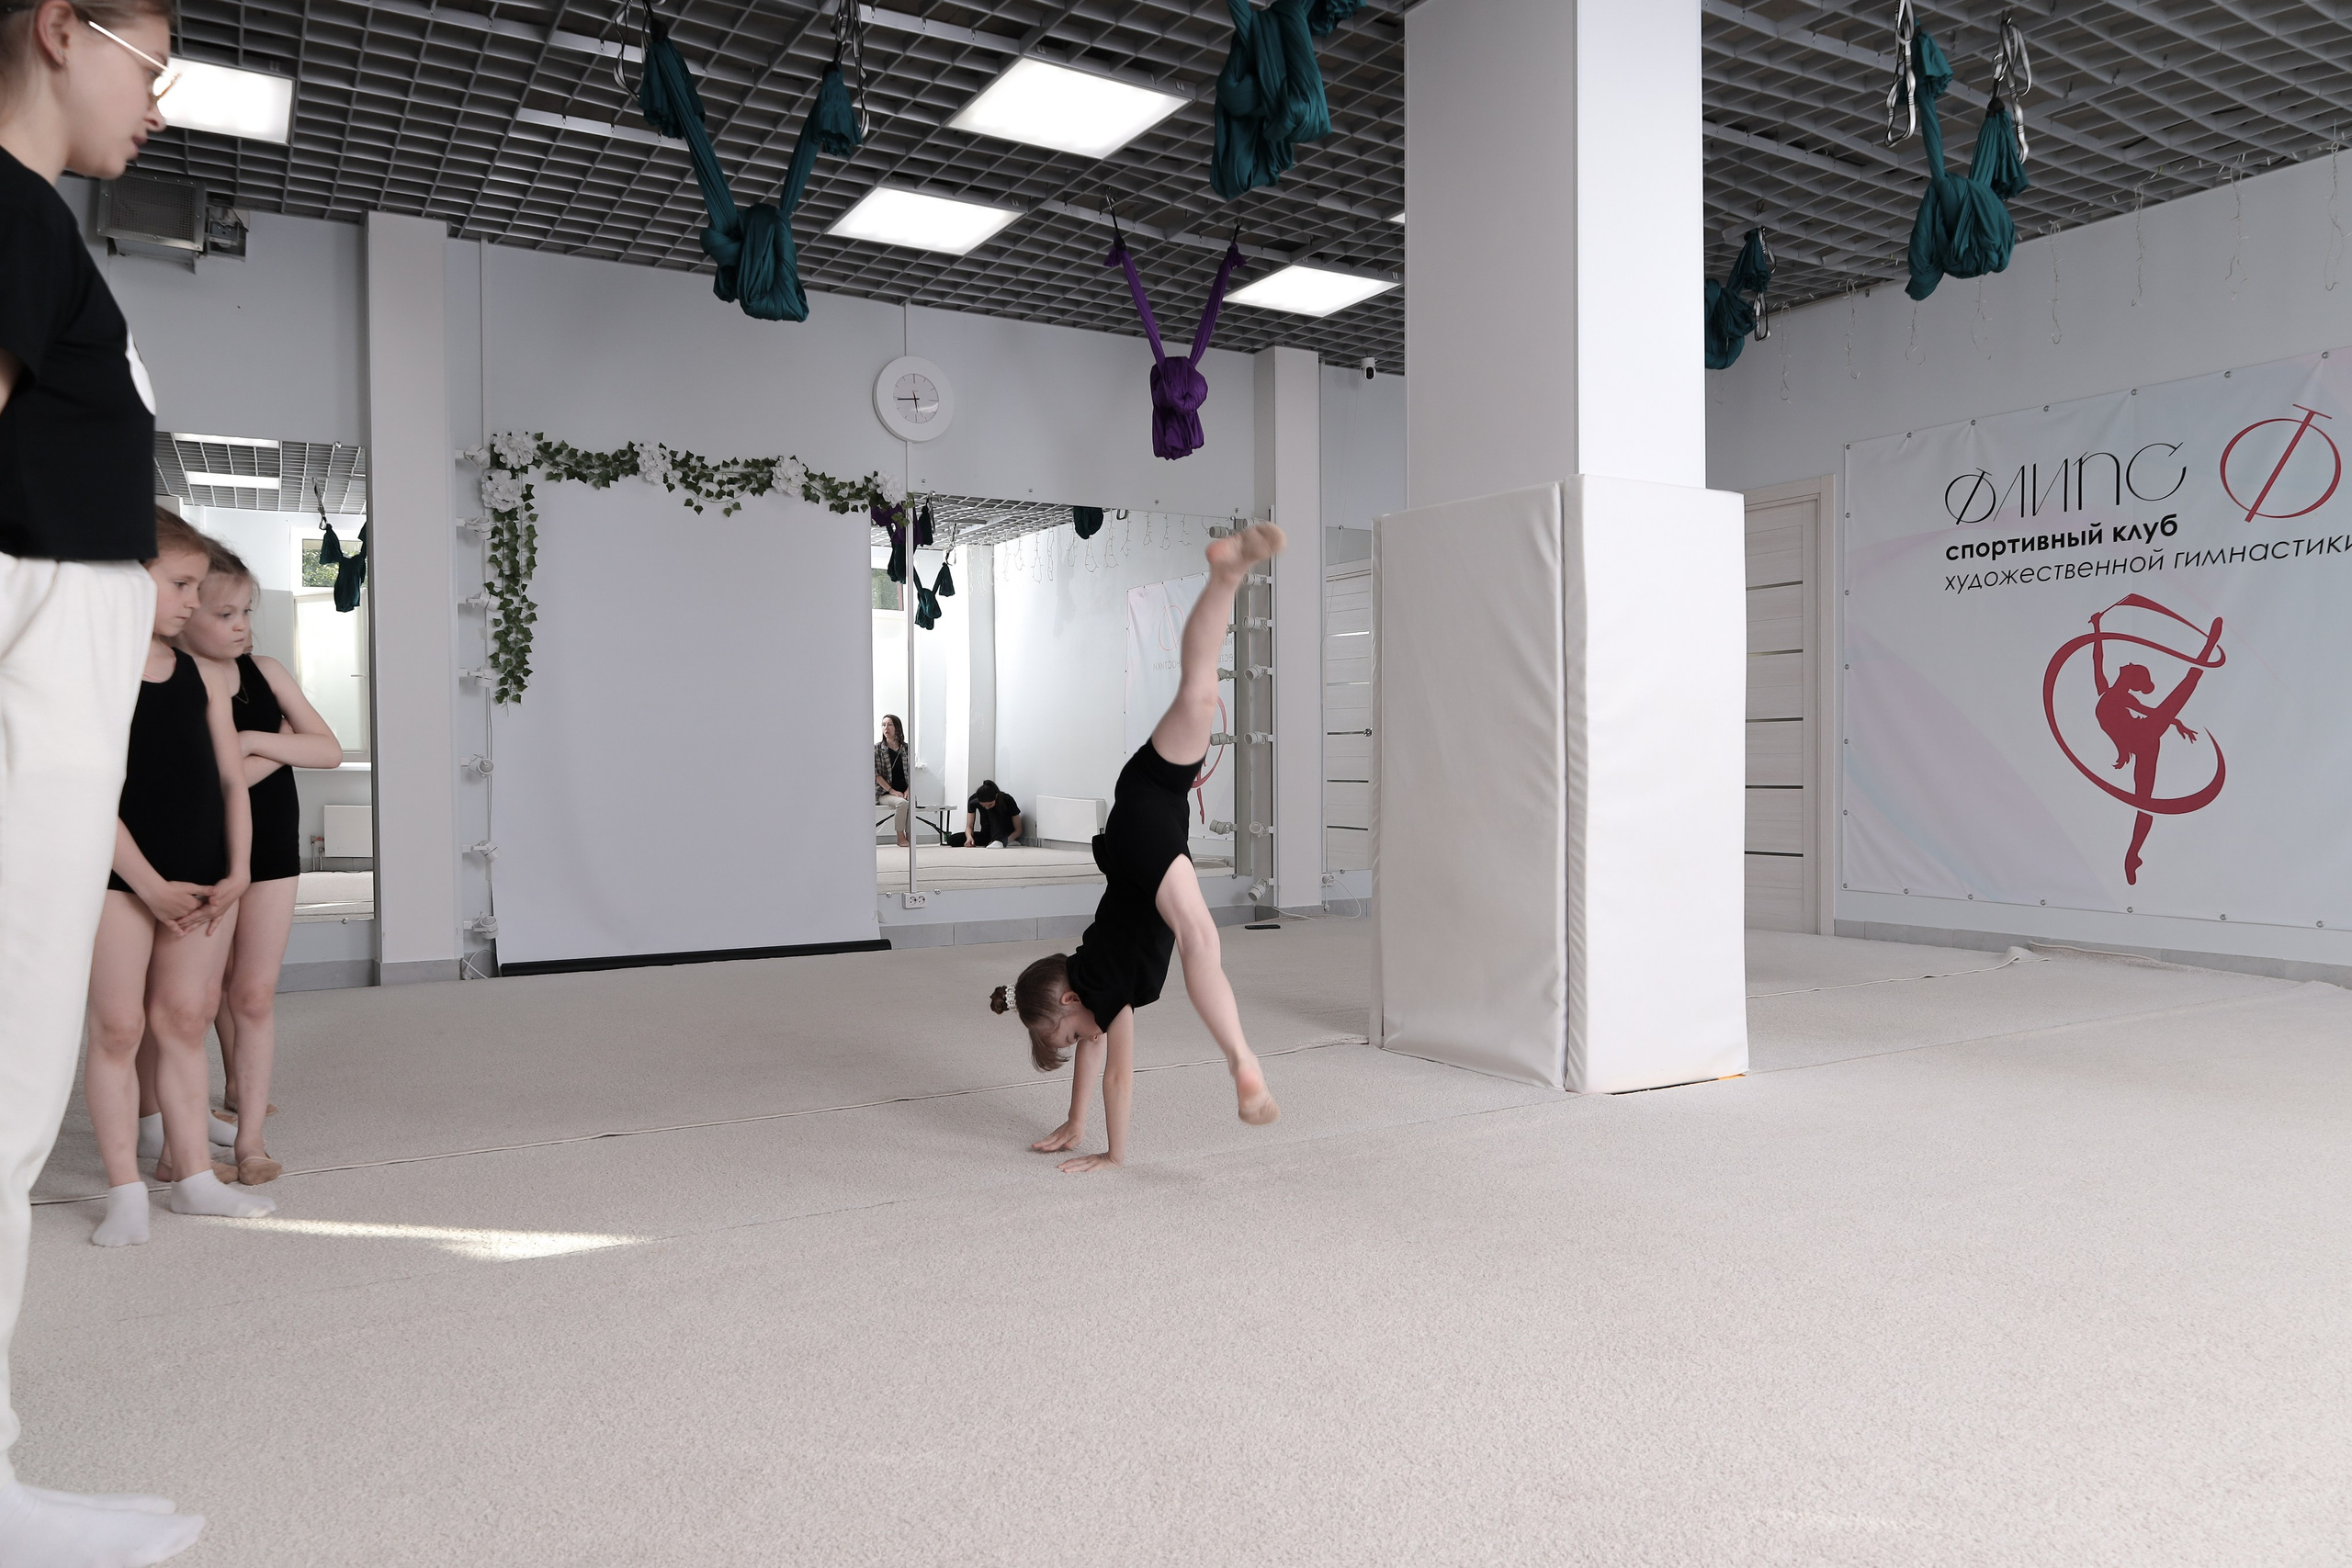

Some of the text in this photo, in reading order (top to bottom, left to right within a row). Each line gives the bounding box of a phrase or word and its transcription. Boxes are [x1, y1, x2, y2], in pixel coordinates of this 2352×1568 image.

[1946, 513, 2178, 560] спортивный клуб
[1944, 548, 2164, 594] художественной
